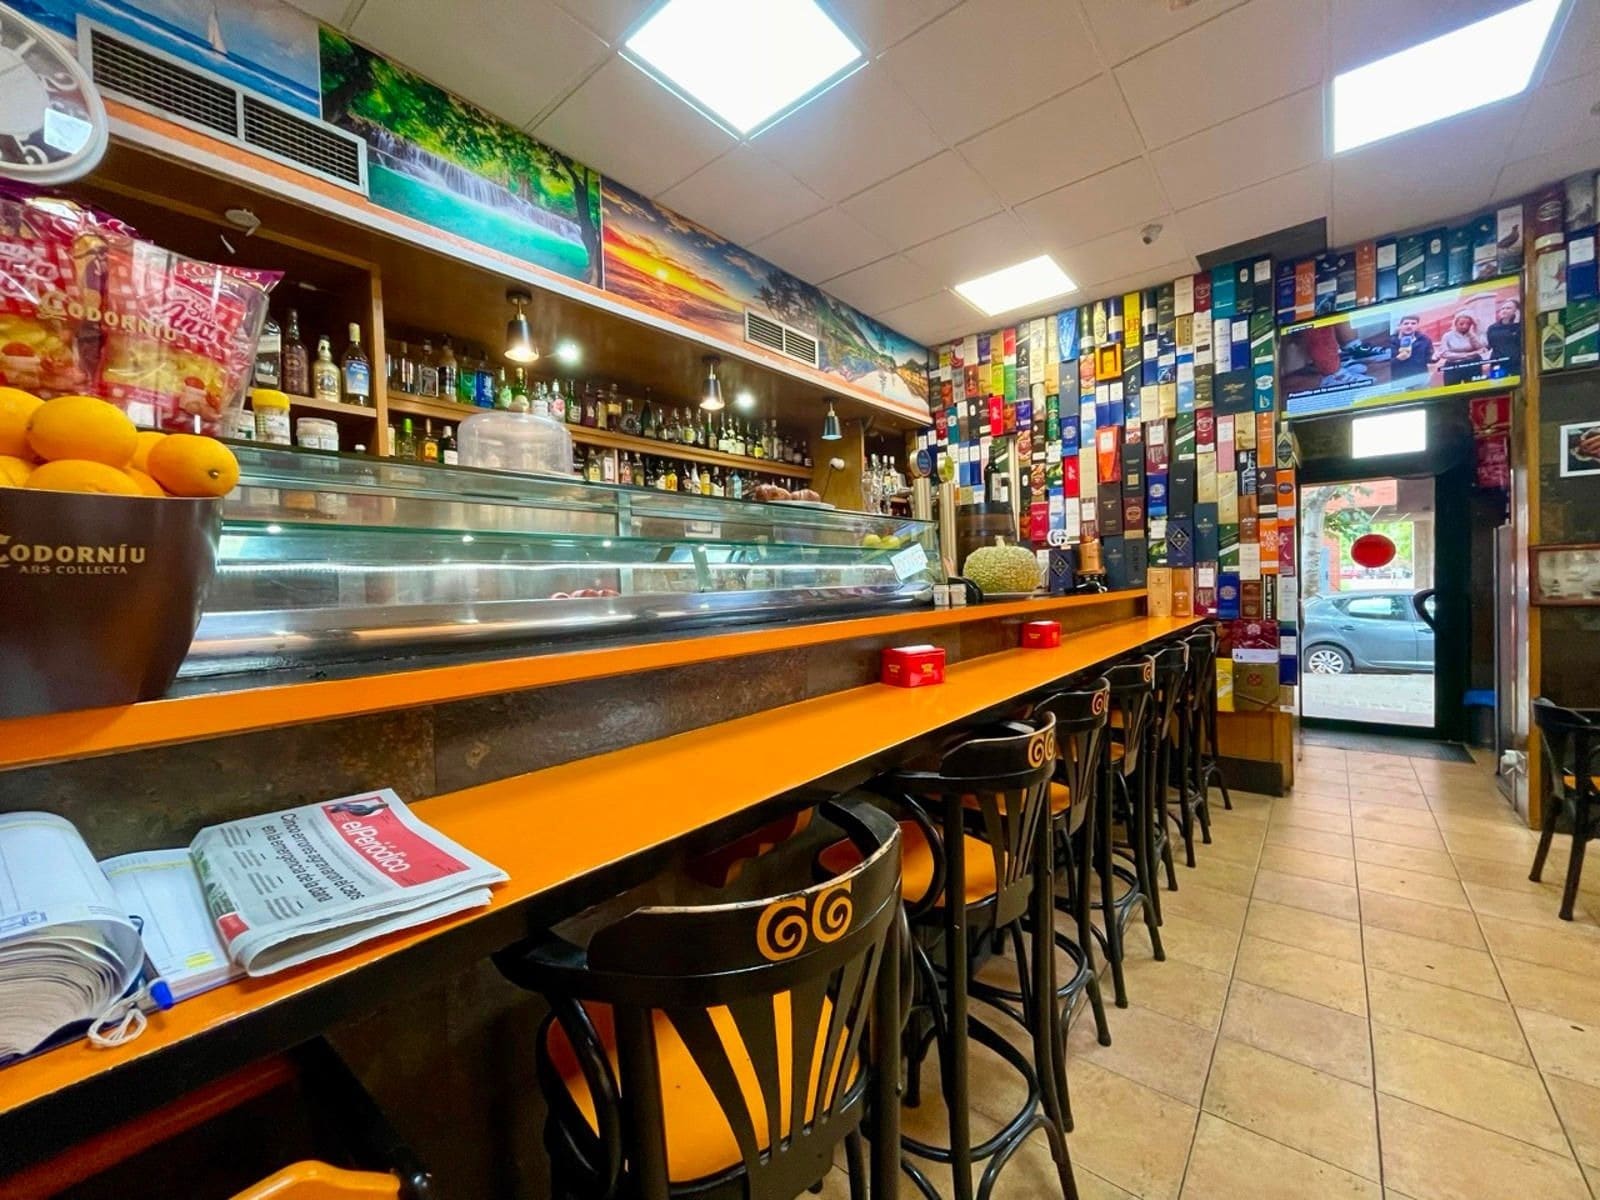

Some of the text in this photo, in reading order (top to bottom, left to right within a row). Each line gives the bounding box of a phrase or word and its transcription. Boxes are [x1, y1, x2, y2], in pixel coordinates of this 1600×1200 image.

[20, 565, 128, 575] ARS COLLECTA
[281, 813, 301, 834] Cinco
